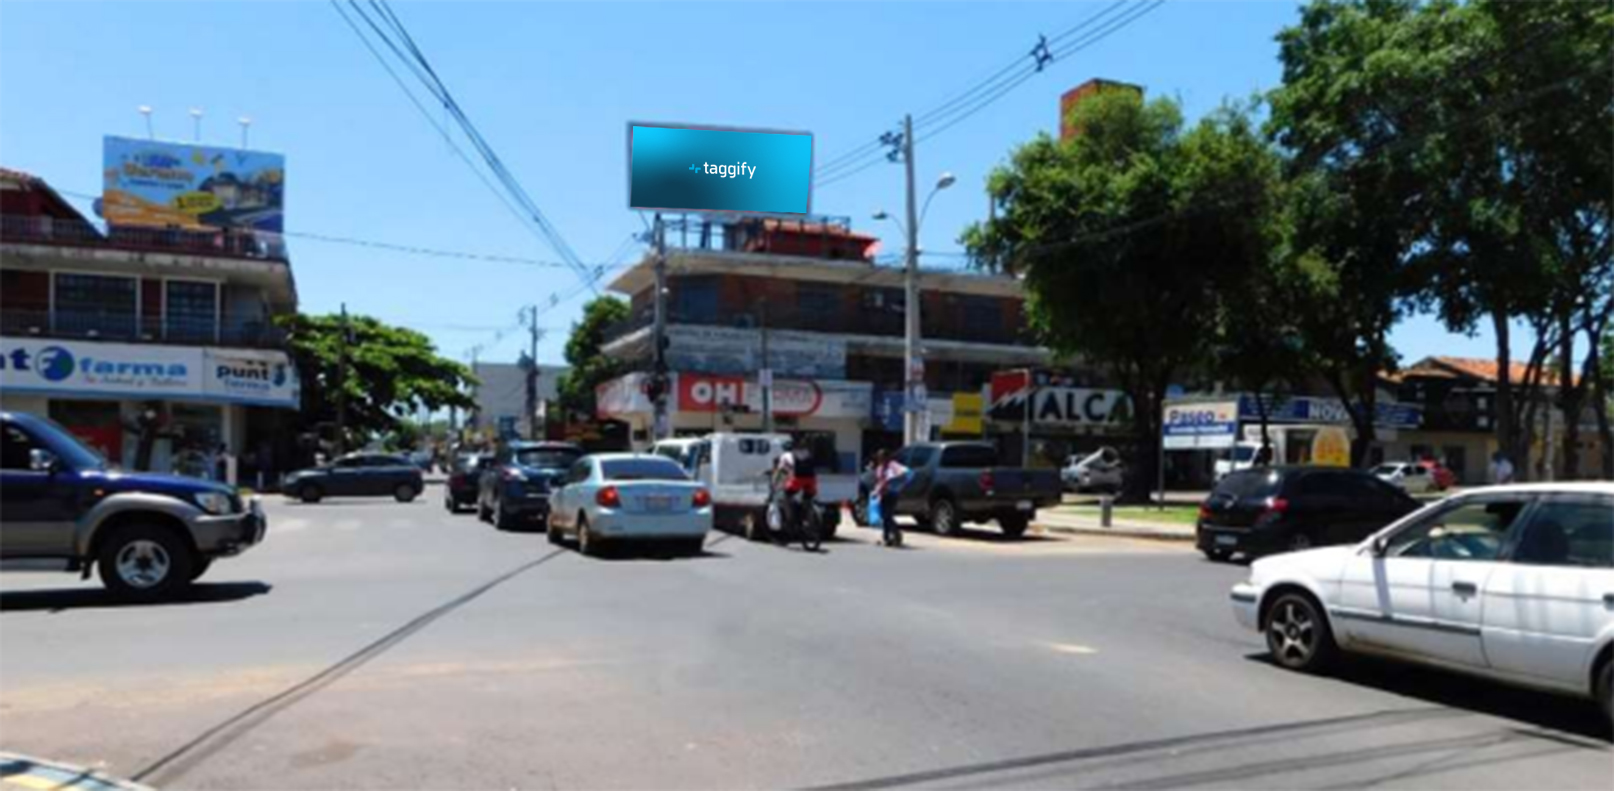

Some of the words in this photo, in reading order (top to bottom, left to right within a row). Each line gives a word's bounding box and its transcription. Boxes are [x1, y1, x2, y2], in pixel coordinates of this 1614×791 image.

[703, 161, 757, 179] taggify
[0, 347, 31, 372] t
[81, 357, 187, 377] farma
[690, 381, 737, 404] OH
